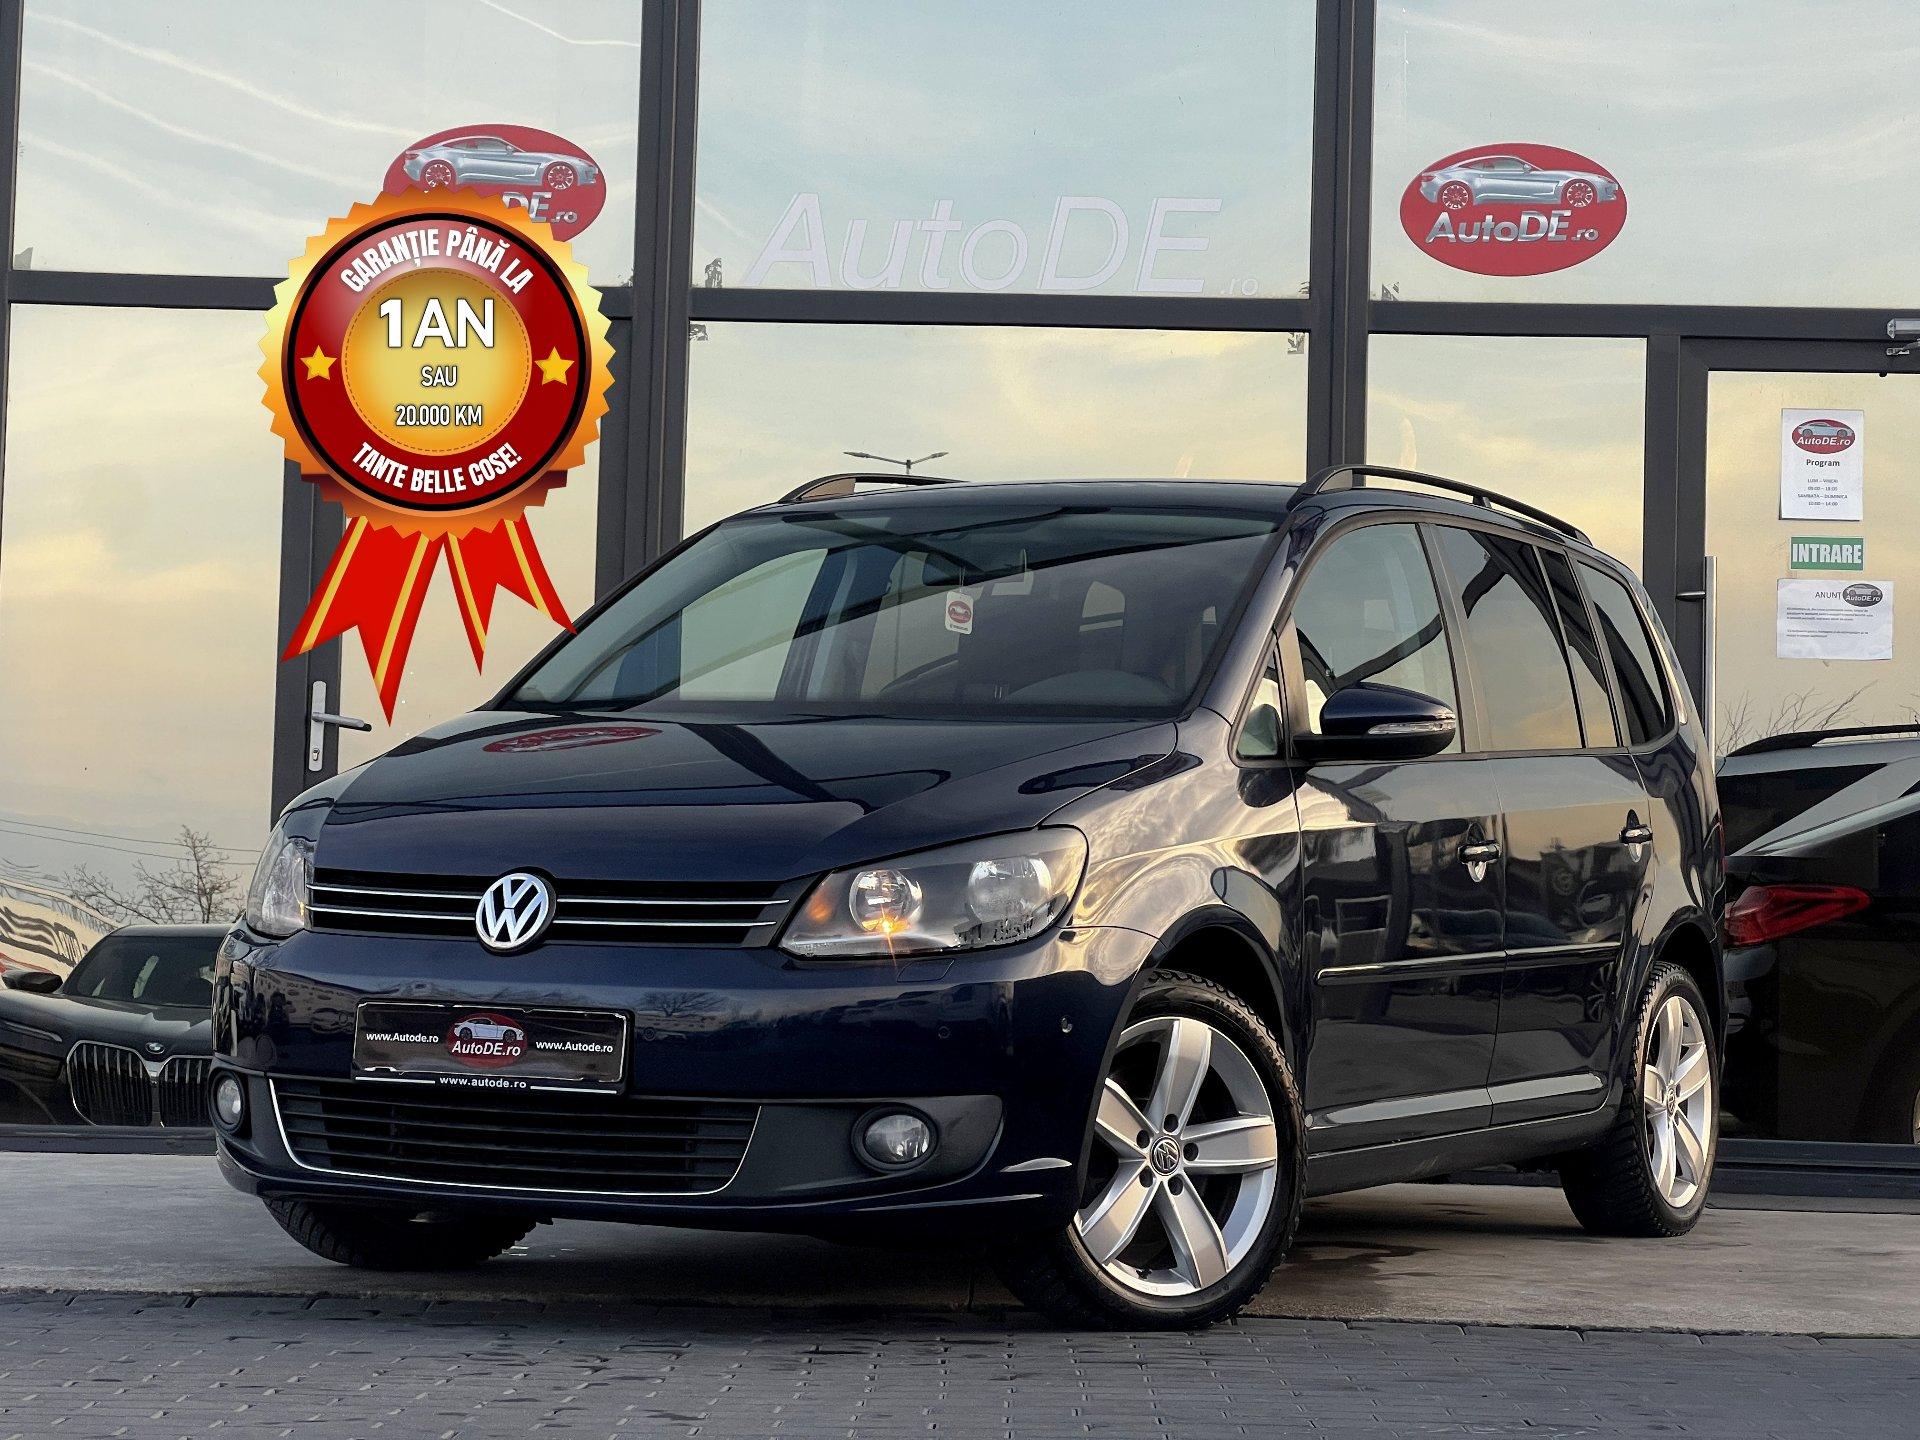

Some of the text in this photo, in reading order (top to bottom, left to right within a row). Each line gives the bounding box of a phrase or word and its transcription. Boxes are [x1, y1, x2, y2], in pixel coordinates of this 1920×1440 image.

[1796, 436, 1851, 446] AutoDE.ro
[1806, 459, 1840, 467] Program
[1792, 543, 1863, 564] INTRARE
[366, 1032, 613, 1056] www.Autode.ro AutoDE.ro www.Autode.ro
[439, 1076, 527, 1089] www.autode.ro
